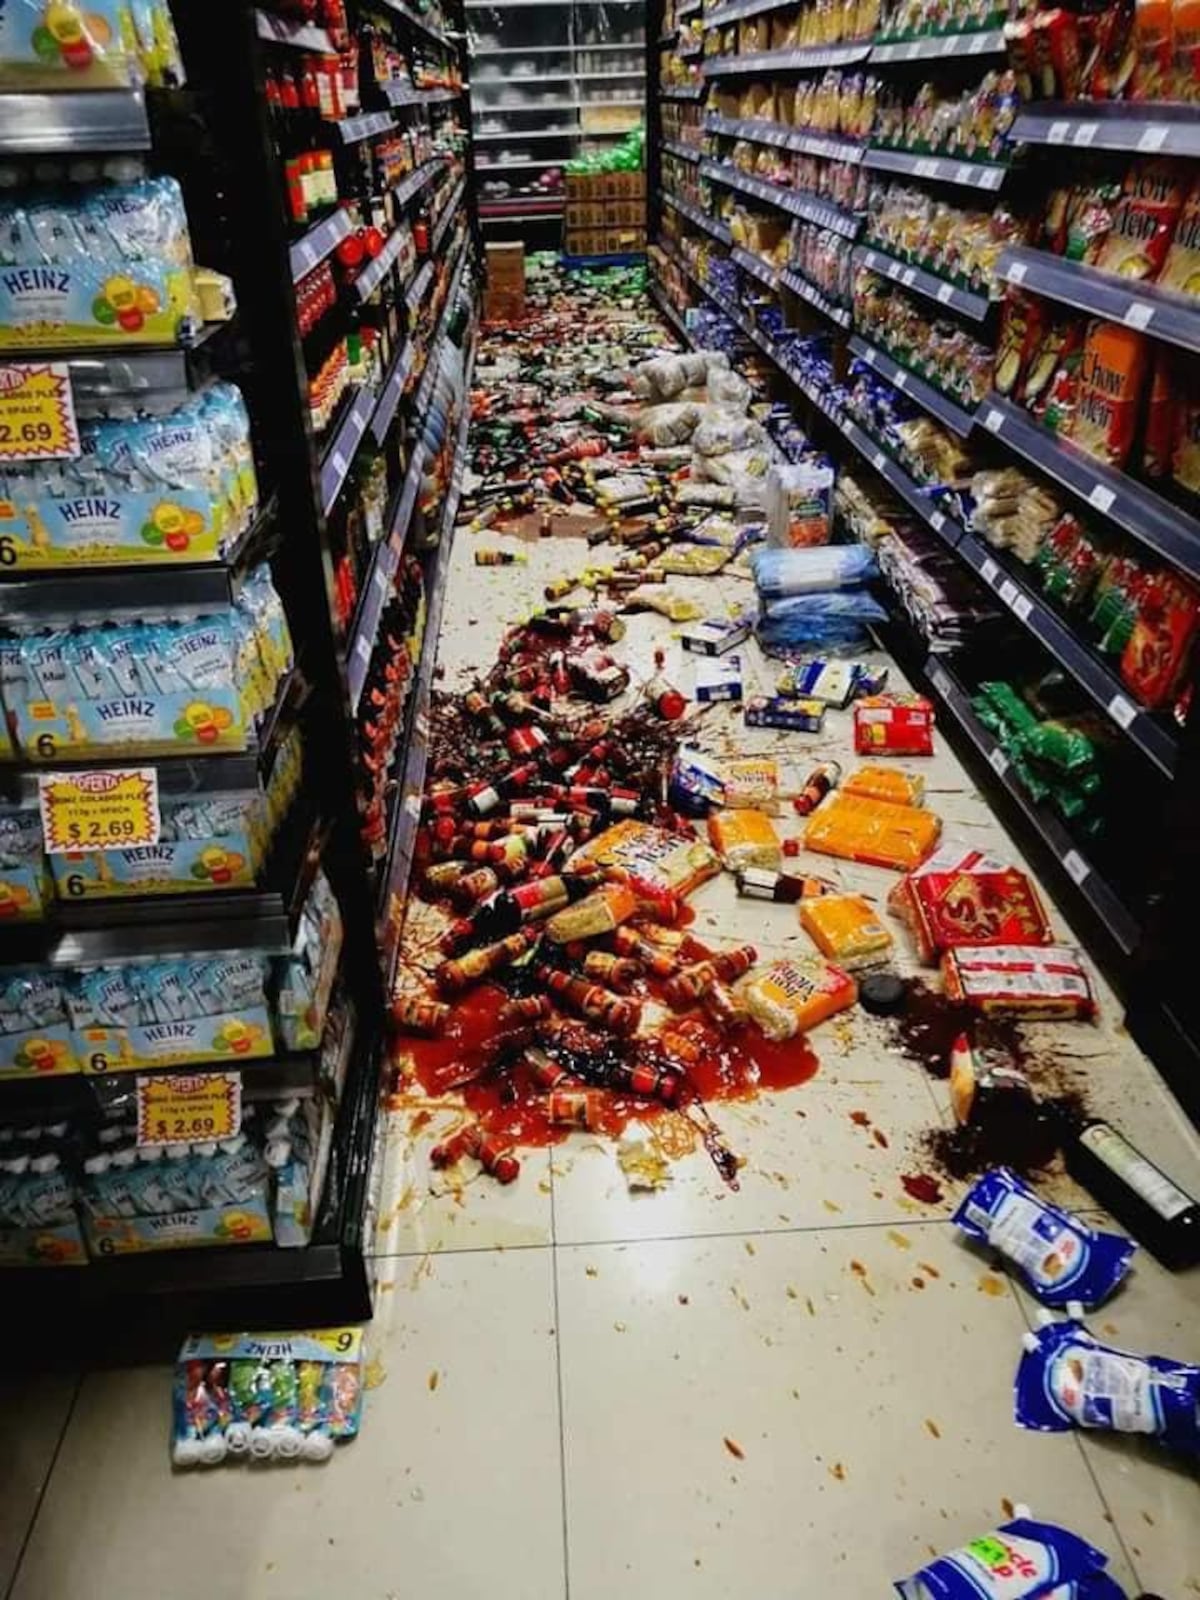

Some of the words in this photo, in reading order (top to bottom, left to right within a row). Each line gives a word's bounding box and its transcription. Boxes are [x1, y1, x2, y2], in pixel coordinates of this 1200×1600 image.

[3, 269, 70, 295] HEINZ
[1082, 352, 1126, 396] Chow
[0, 422, 52, 443] 2.69
[151, 431, 193, 452] HEINZ
[59, 499, 121, 523] HEINZ
[0, 536, 17, 566] 6
[96, 699, 156, 721] HEINZ
[37, 733, 56, 758] 6
[69, 822, 81, 839] $
[89, 820, 134, 837] 2.69
[121, 847, 175, 864] HEINZ
[66, 874, 86, 896] 6
[144, 1024, 197, 1041] HEINZ
[91, 1053, 108, 1072] 6
[157, 1120, 167, 1135] $
[174, 1118, 214, 1133] 2.69
[150, 1213, 199, 1229] HEINZ
[246, 1342, 293, 1356] HEINZ
